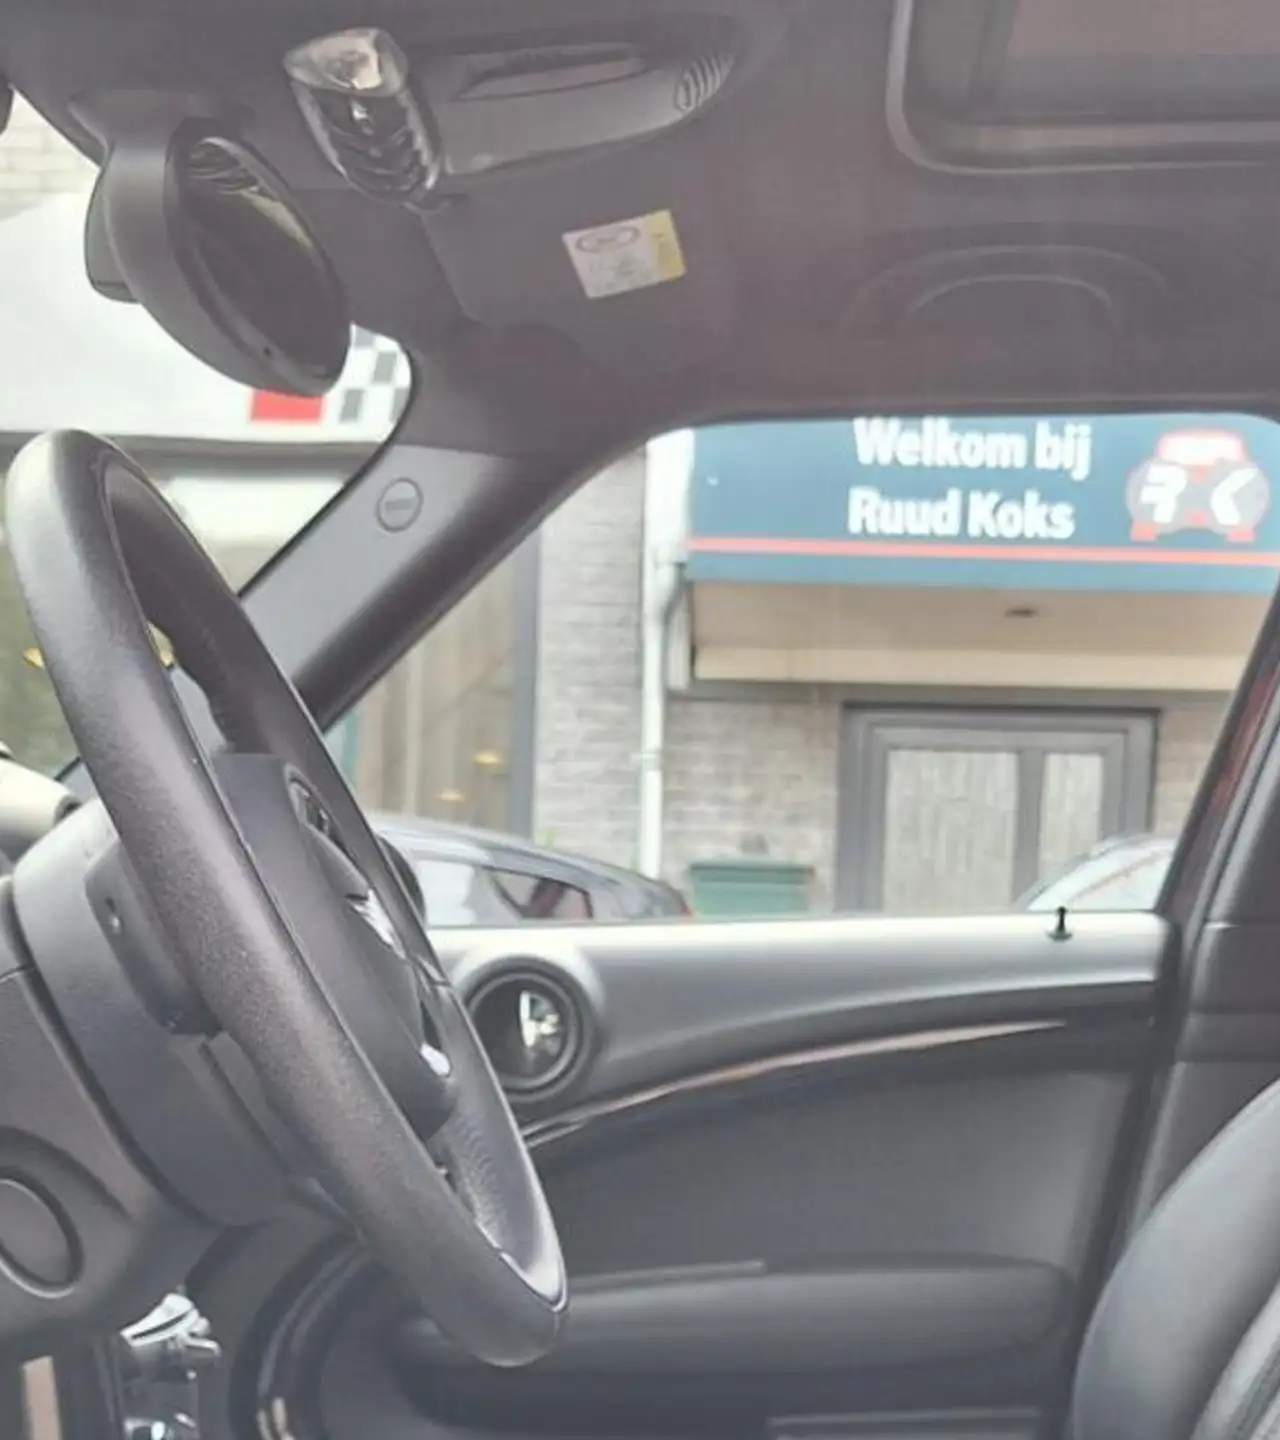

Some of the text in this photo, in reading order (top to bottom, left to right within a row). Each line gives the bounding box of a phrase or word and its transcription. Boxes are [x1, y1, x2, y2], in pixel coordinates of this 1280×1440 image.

[853, 417, 1092, 481] Welkom bij
[849, 486, 1076, 539] Ruud Koks
